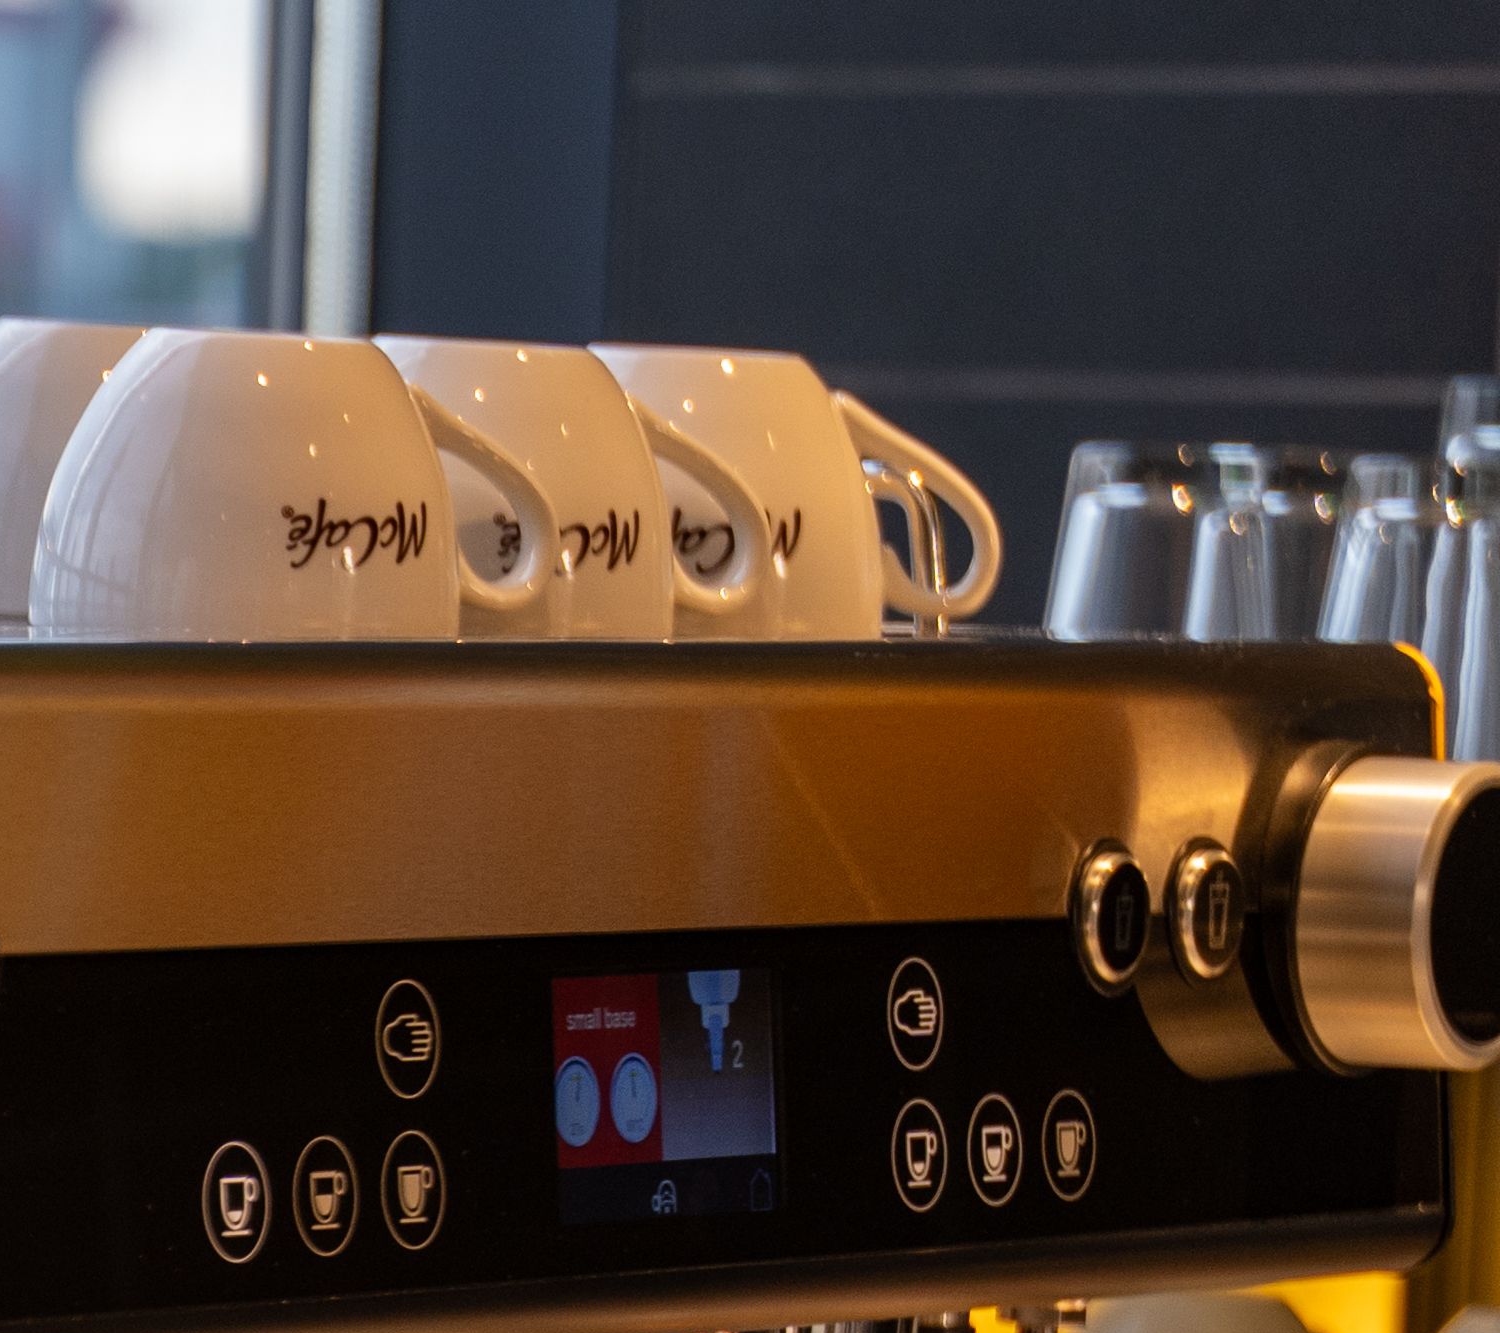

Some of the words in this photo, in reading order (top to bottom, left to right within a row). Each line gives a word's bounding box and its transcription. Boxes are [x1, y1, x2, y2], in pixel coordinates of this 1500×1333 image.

[282, 498, 426, 573] McCafé
[566, 1009, 601, 1031] small
[604, 1006, 636, 1029] base
[731, 1040, 744, 1068] 2
